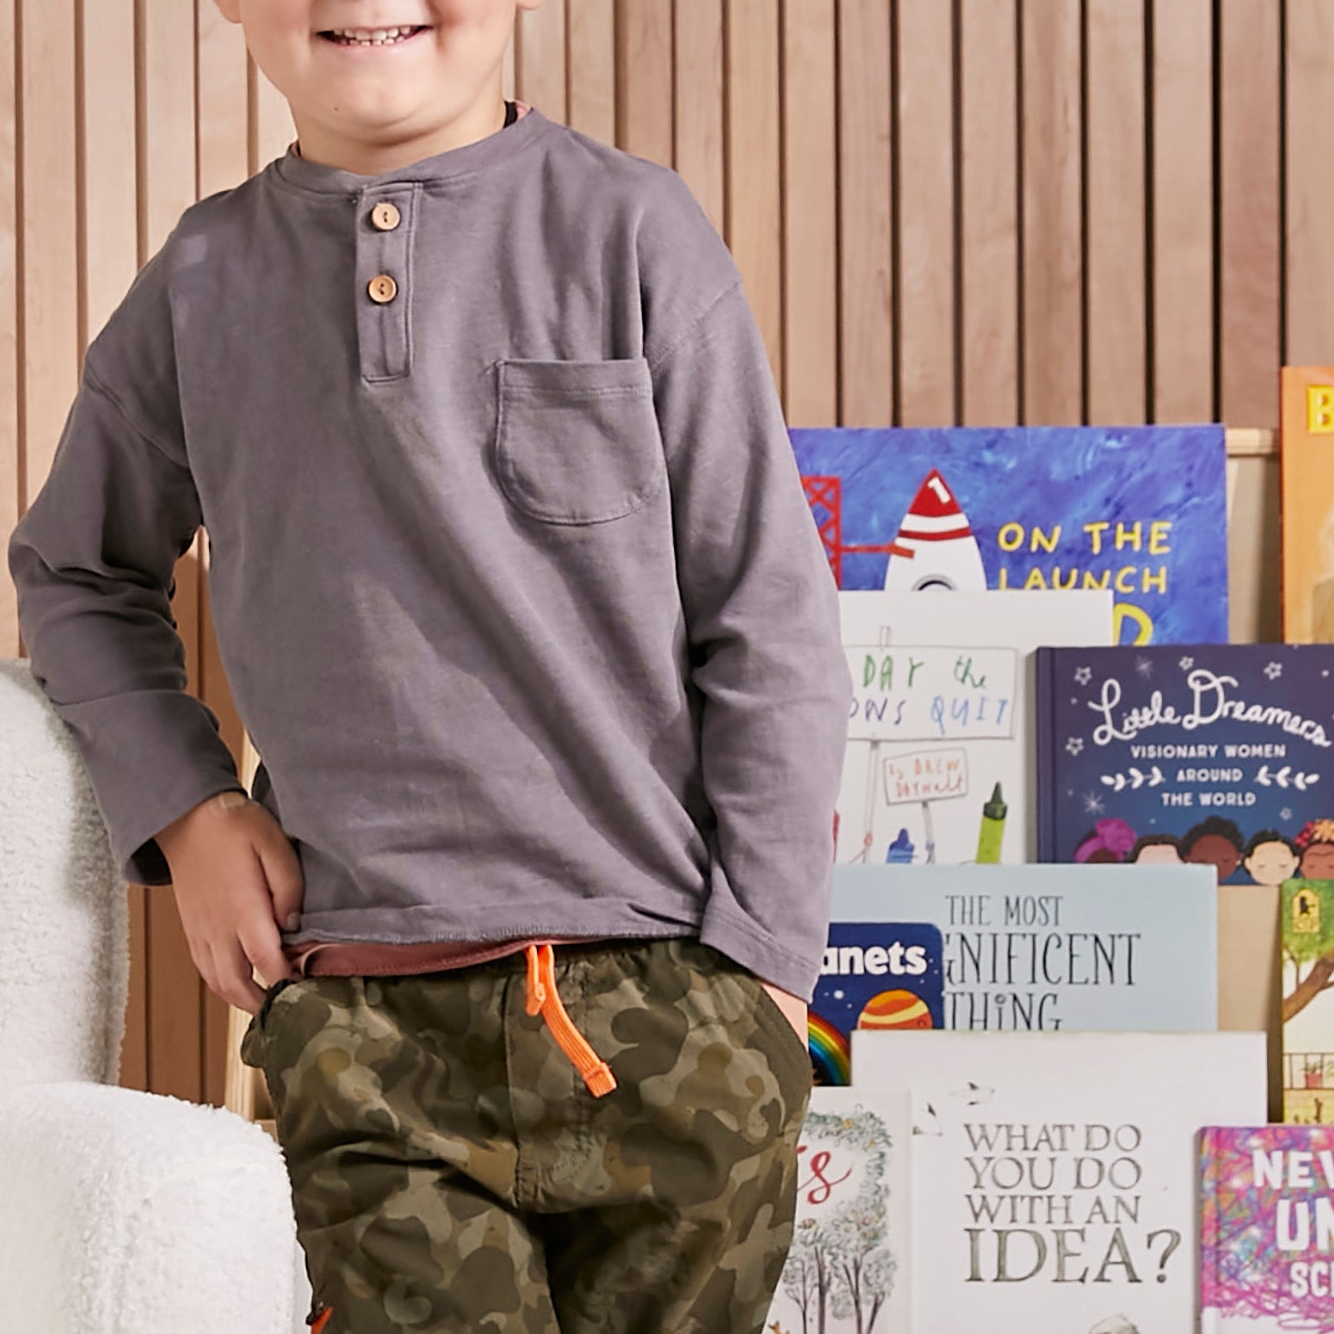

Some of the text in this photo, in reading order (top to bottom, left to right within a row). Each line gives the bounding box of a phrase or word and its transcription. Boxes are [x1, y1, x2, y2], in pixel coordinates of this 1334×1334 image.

[927, 475, 952, 504] 1
[997, 521, 1173, 554] ON THE
[998, 565, 1168, 594] LAUNCH
[862, 653, 925, 692] DAY
[930, 694, 1009, 736] QUIT
[1087, 669, 1333, 748] Little Dreamers
[1130, 743, 1287, 759] VISIONARY WOMEN
[1175, 768, 1244, 783] AROUND
[1160, 791, 1257, 807] THE WORLD
[945, 894, 1064, 927] THE MOST
[820, 941, 928, 976] anets
[963, 1122, 1142, 1153] WHAT DO
[963, 1155, 1143, 1191] YOU DO
[963, 1193, 1142, 1225] WITH AN
[963, 1225, 1182, 1284] IDEA?
